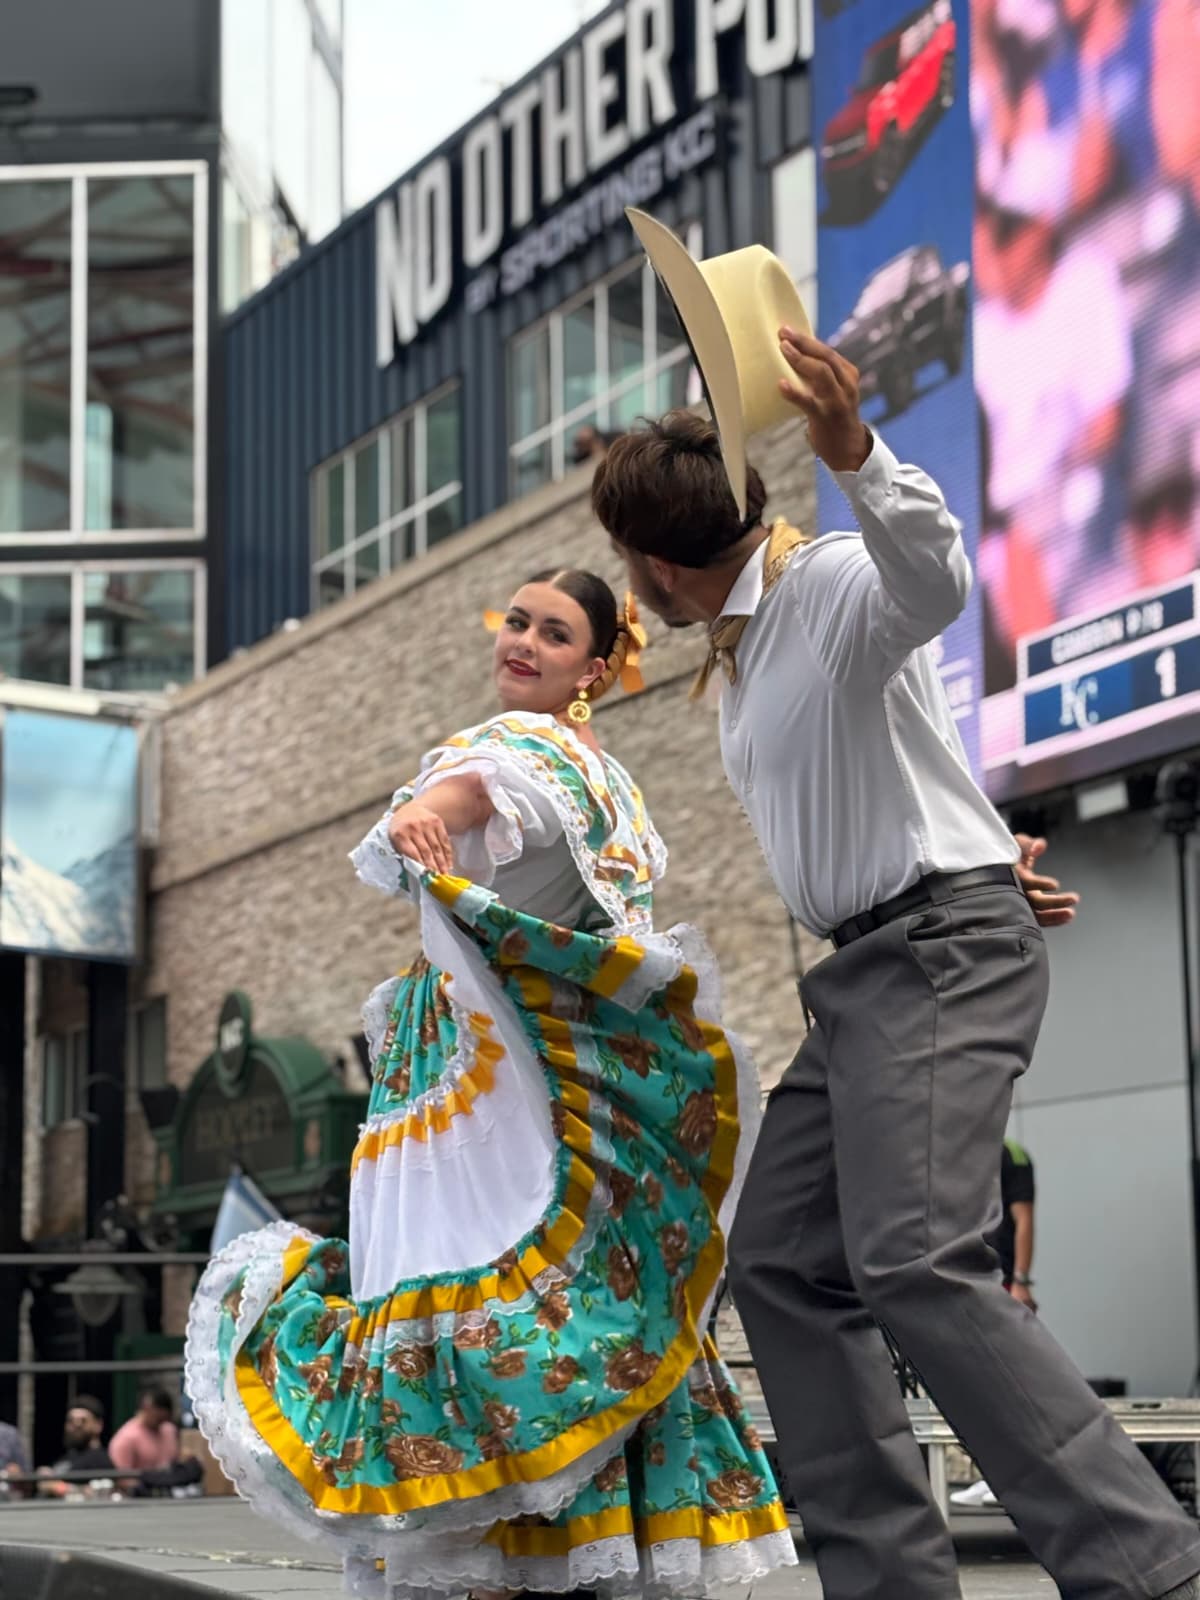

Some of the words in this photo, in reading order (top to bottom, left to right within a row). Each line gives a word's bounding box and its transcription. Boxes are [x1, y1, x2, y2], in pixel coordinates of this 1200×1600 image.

[375, 155, 453, 369] NO
[462, 0, 677, 269] OTHER
[500, 147, 664, 296] SPORTING
[663, 107, 716, 182] KC
[1154, 646, 1177, 699] 1
